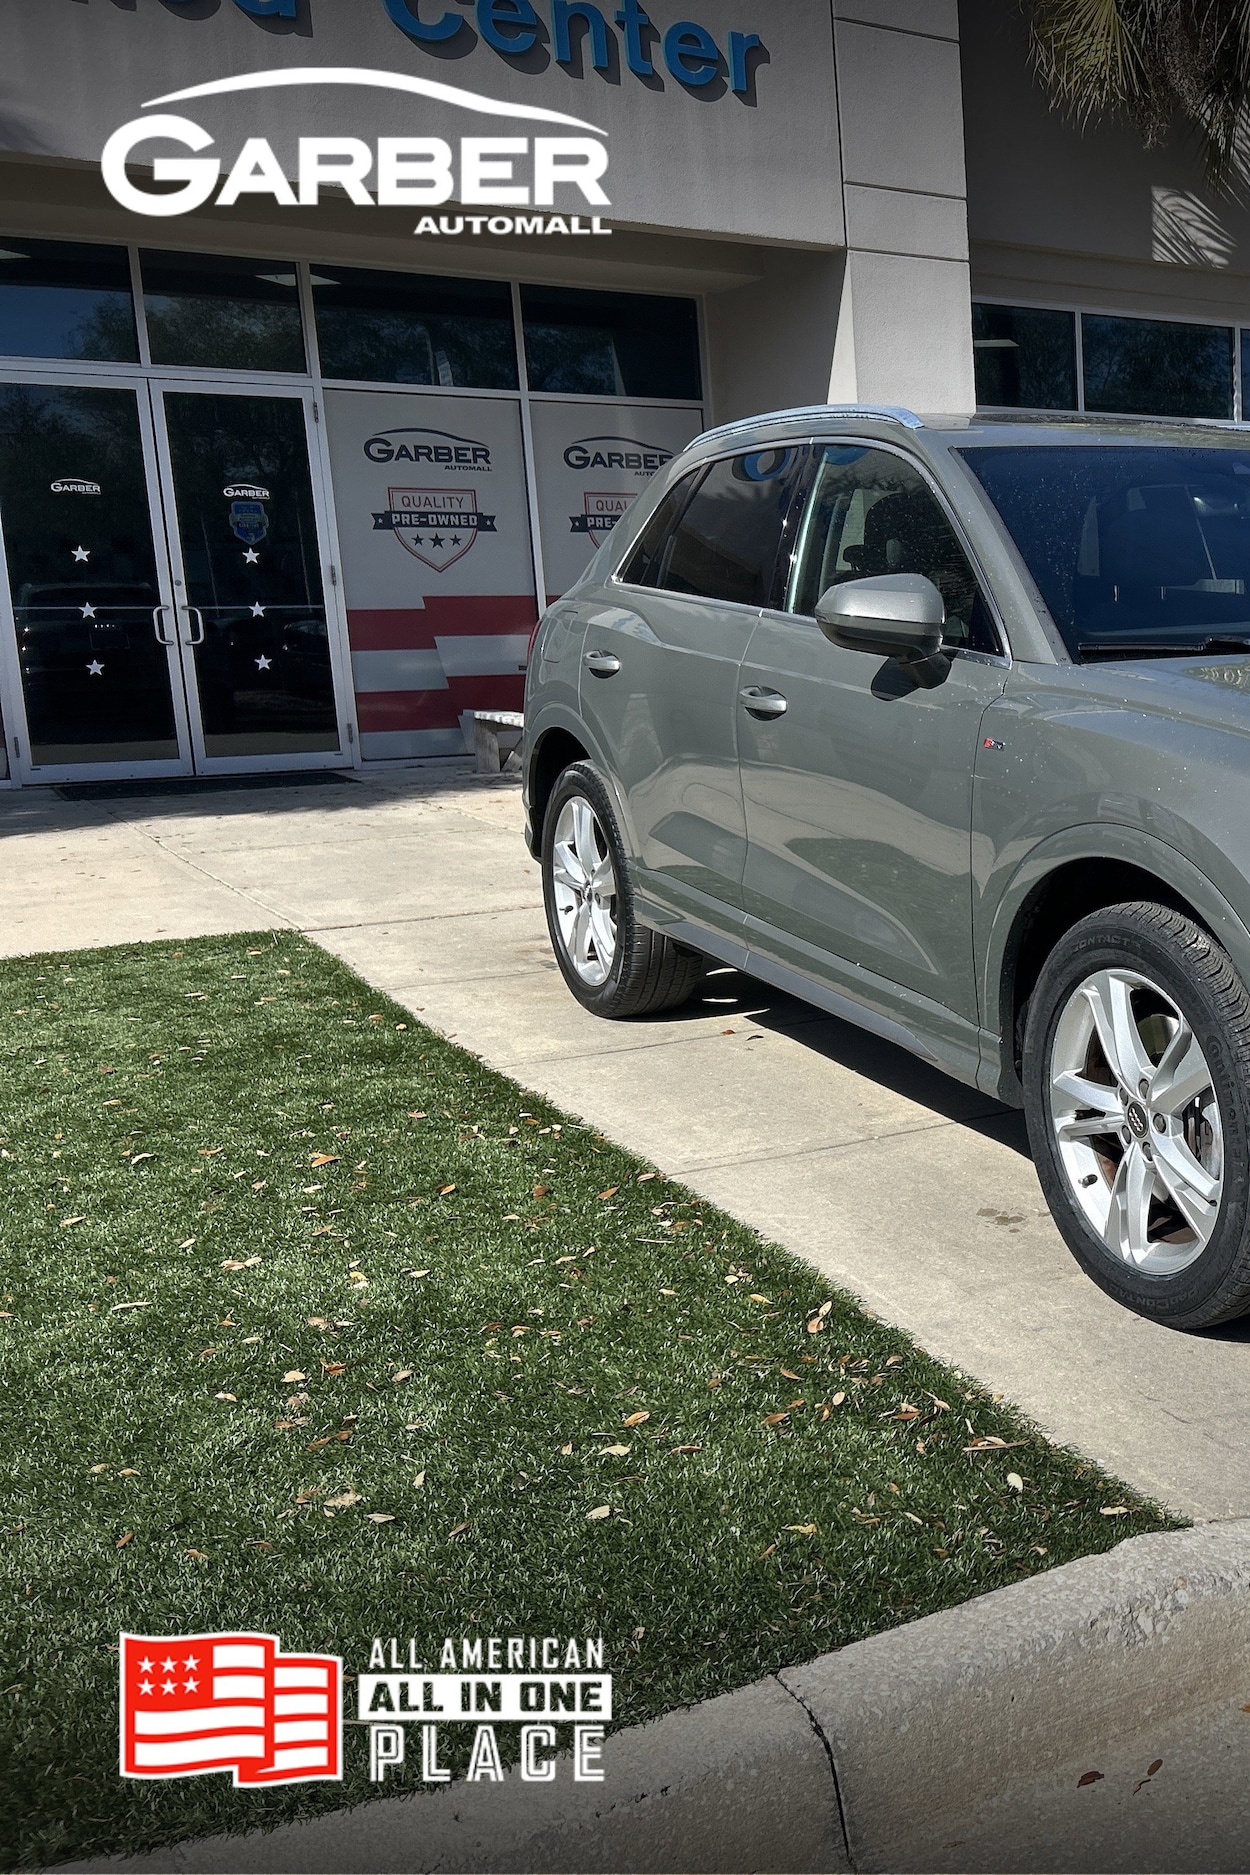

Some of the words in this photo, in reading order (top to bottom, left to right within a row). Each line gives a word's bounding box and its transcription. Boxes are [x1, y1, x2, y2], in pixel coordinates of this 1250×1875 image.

[363, 437, 492, 464] GARBER
[401, 495, 464, 509] QUALITY
[391, 513, 478, 527] PRE-OWNED
